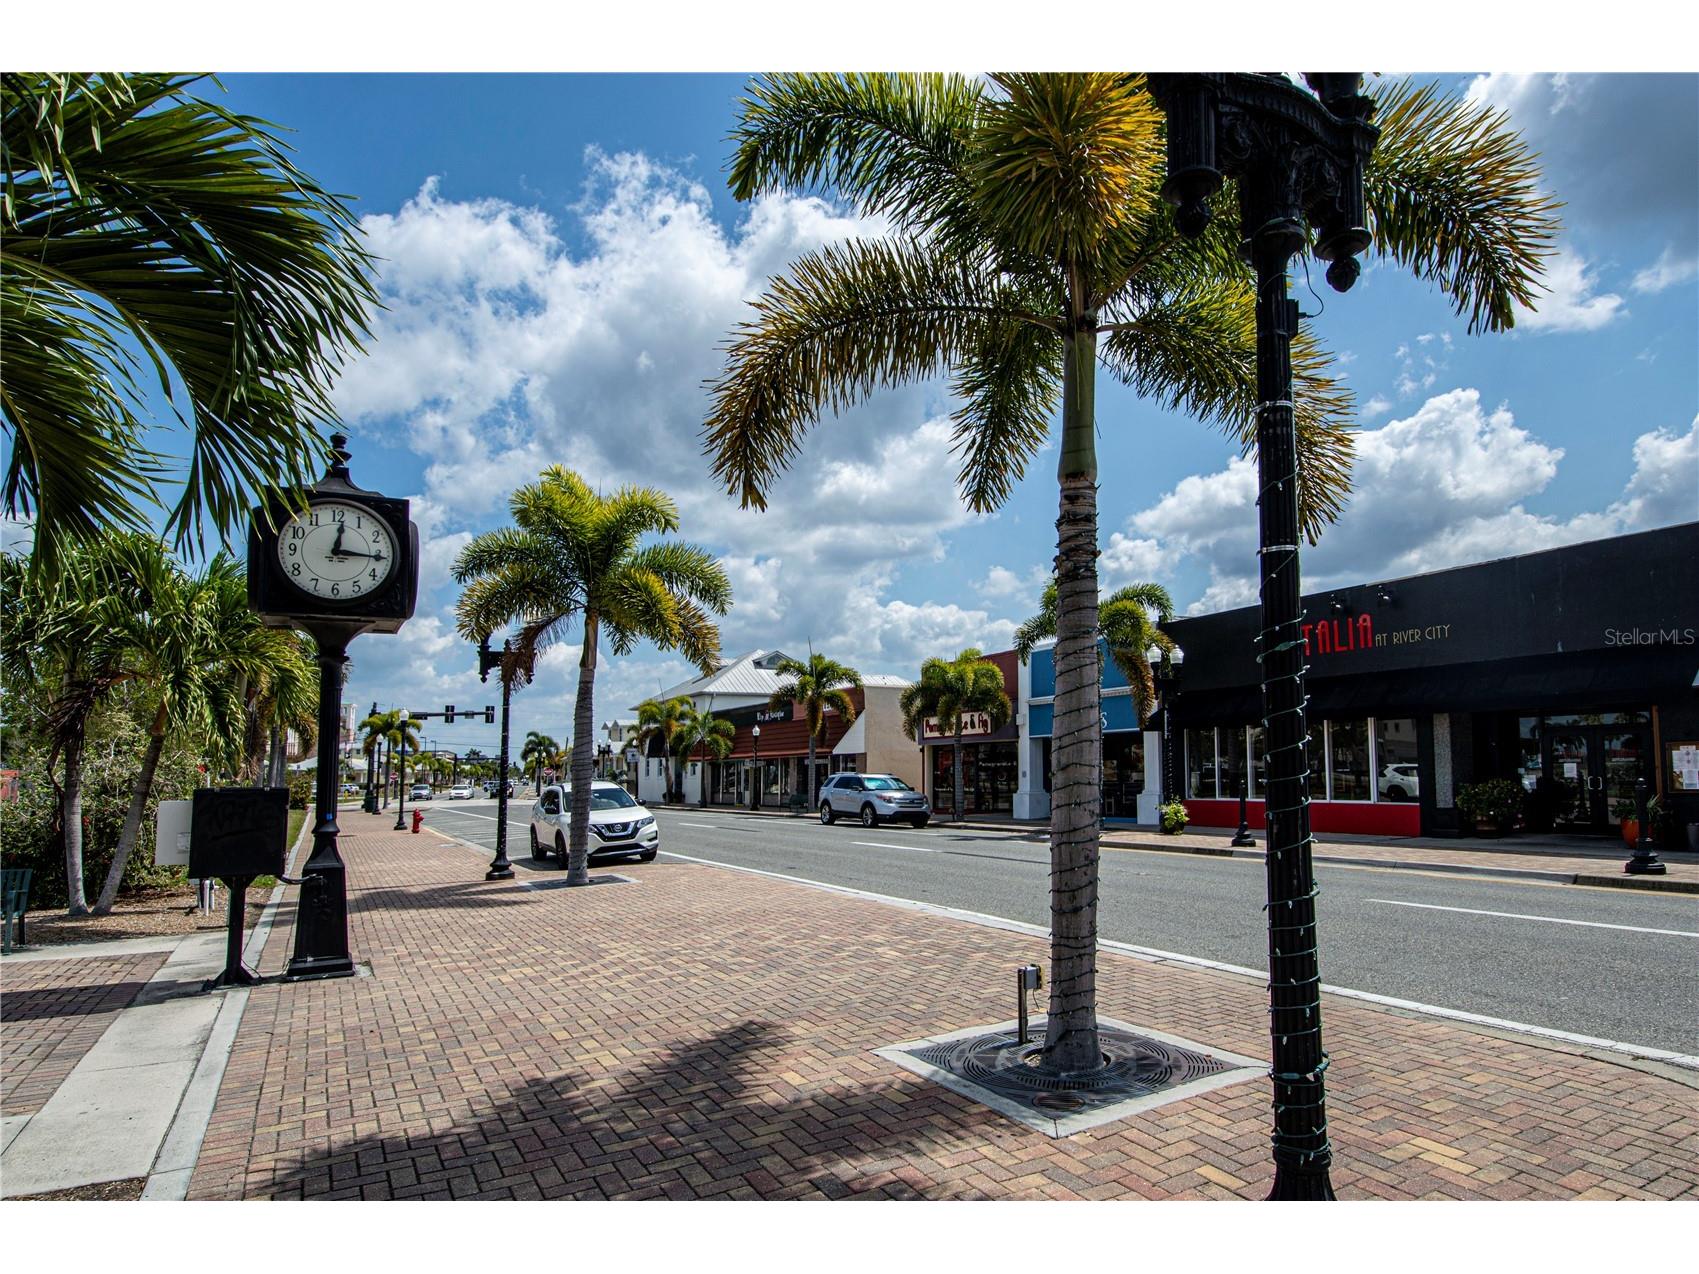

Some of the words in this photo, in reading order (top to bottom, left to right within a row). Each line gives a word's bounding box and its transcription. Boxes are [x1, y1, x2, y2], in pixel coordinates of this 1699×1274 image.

[332, 510, 345, 523] 12
[356, 516, 362, 529] 1
[292, 526, 305, 539] 10
[372, 530, 380, 543] 2
[289, 543, 297, 556] 9
[291, 563, 301, 577] 8
[369, 568, 378, 580] 4
[310, 578, 321, 592] 7
[331, 583, 340, 597] 6
[352, 580, 361, 593] 5
[1375, 633, 1388, 647] AT
[1393, 628, 1422, 645] RIVER
[1424, 624, 1451, 640] CITY
